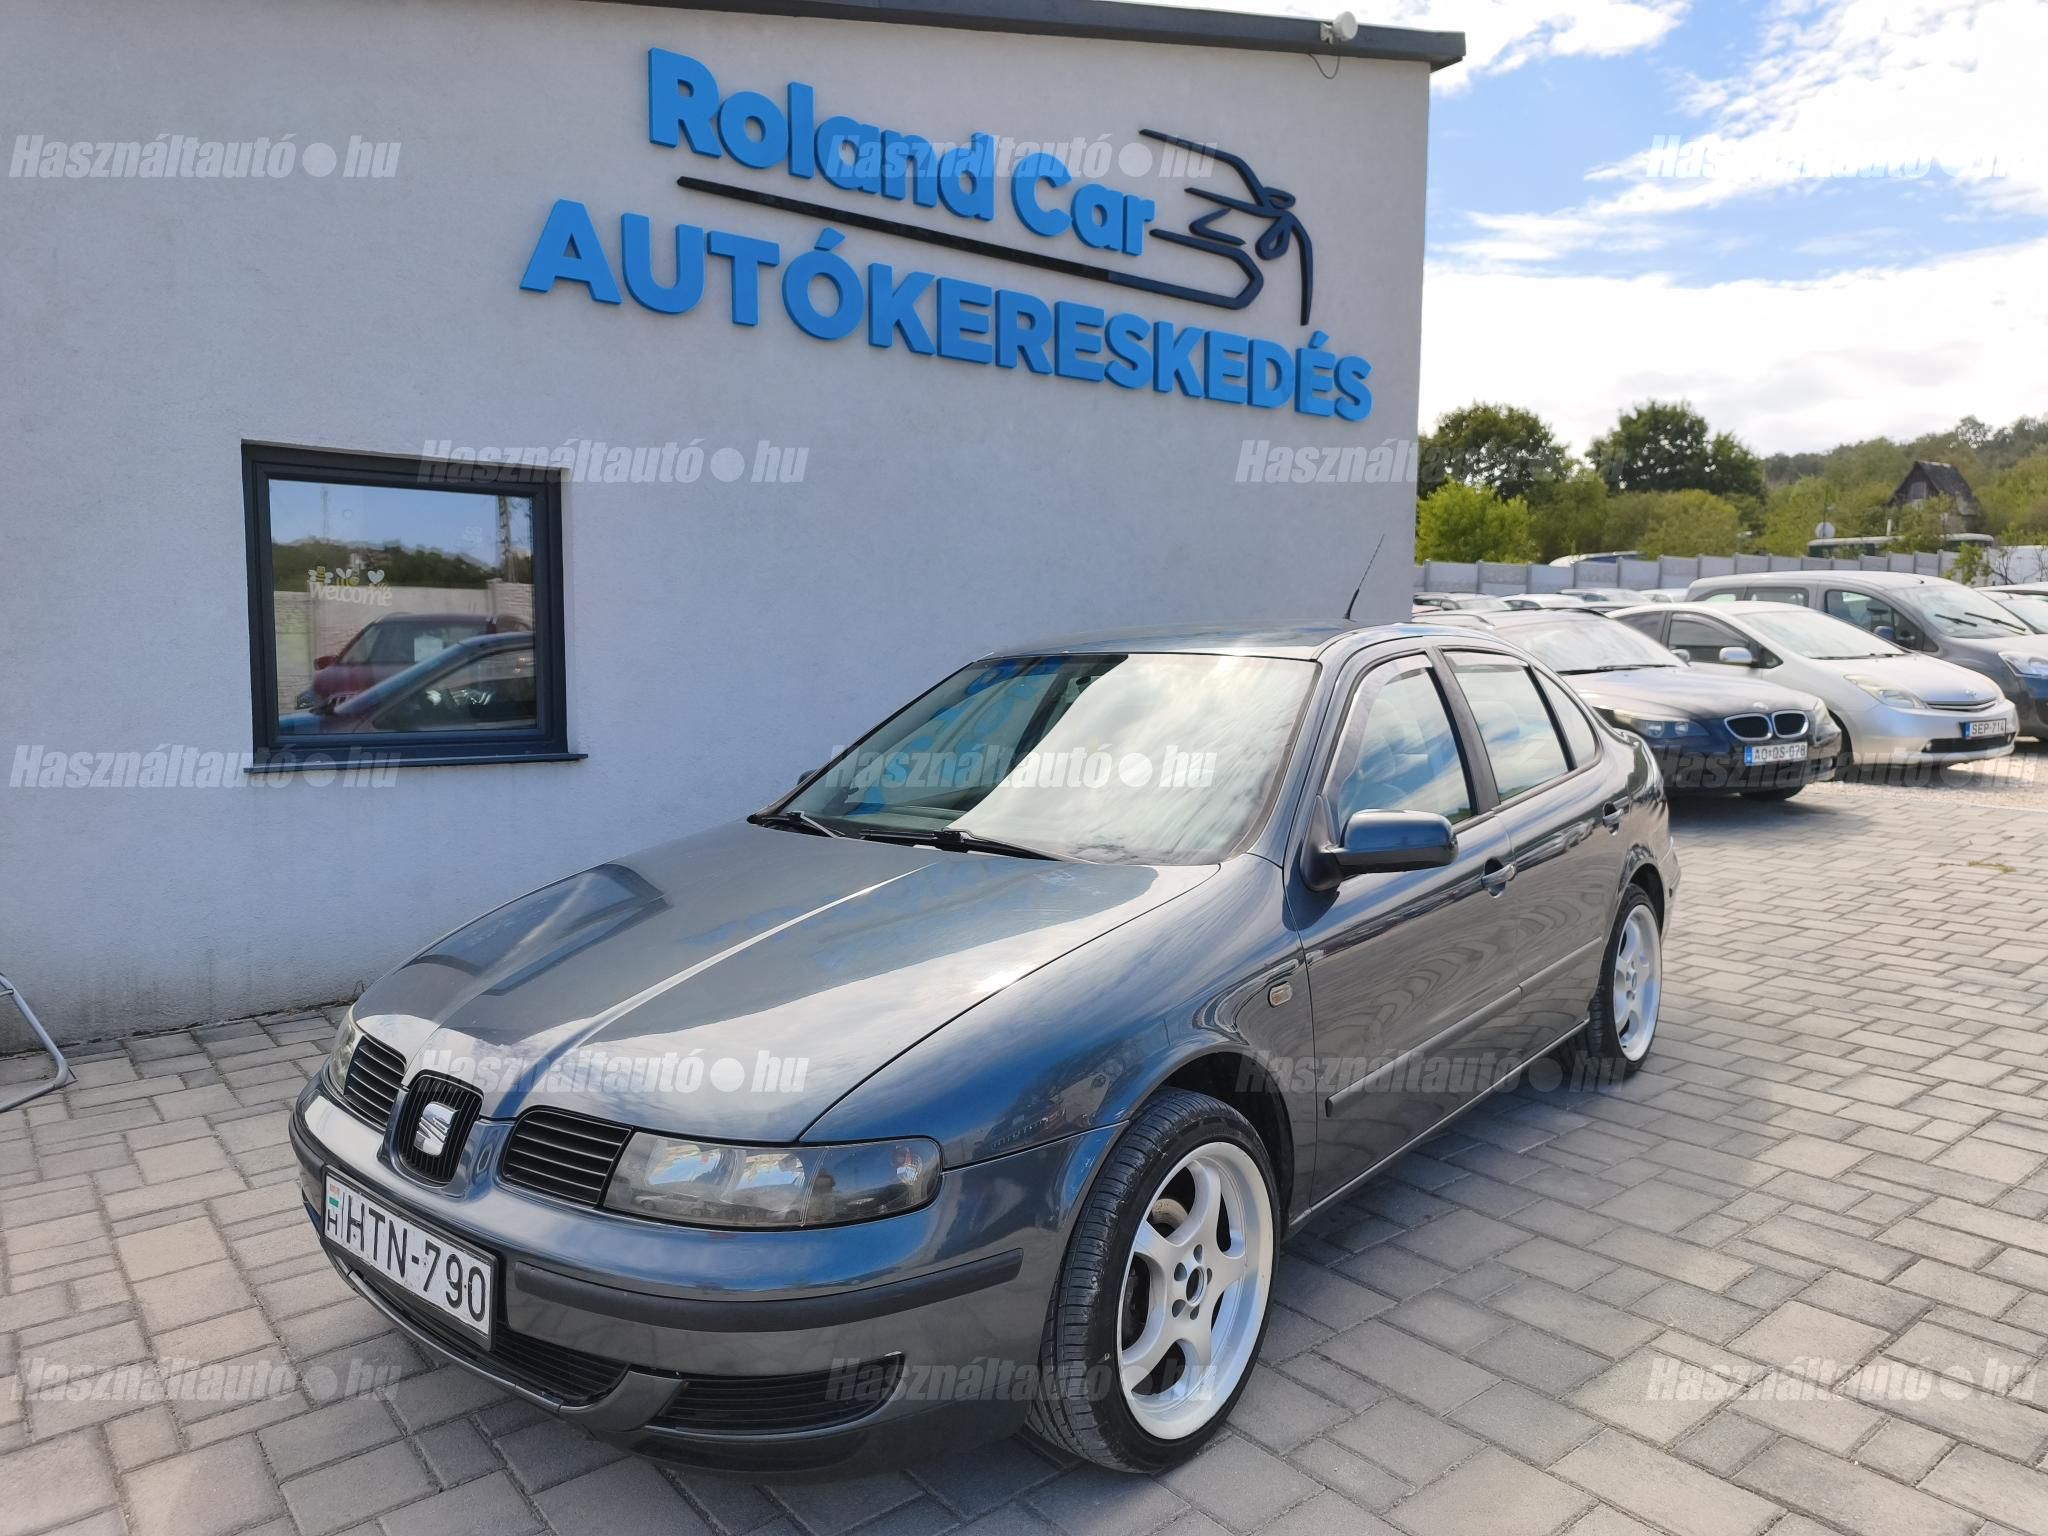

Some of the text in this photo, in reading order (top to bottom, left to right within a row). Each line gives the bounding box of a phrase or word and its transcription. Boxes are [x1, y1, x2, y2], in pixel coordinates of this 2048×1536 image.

[647, 47, 1156, 256] Roland Car
[519, 199, 1373, 422] AUTÓKERESKEDÉS
[307, 580, 392, 606] Welcome
[347, 1195, 486, 1322] HTN-790
